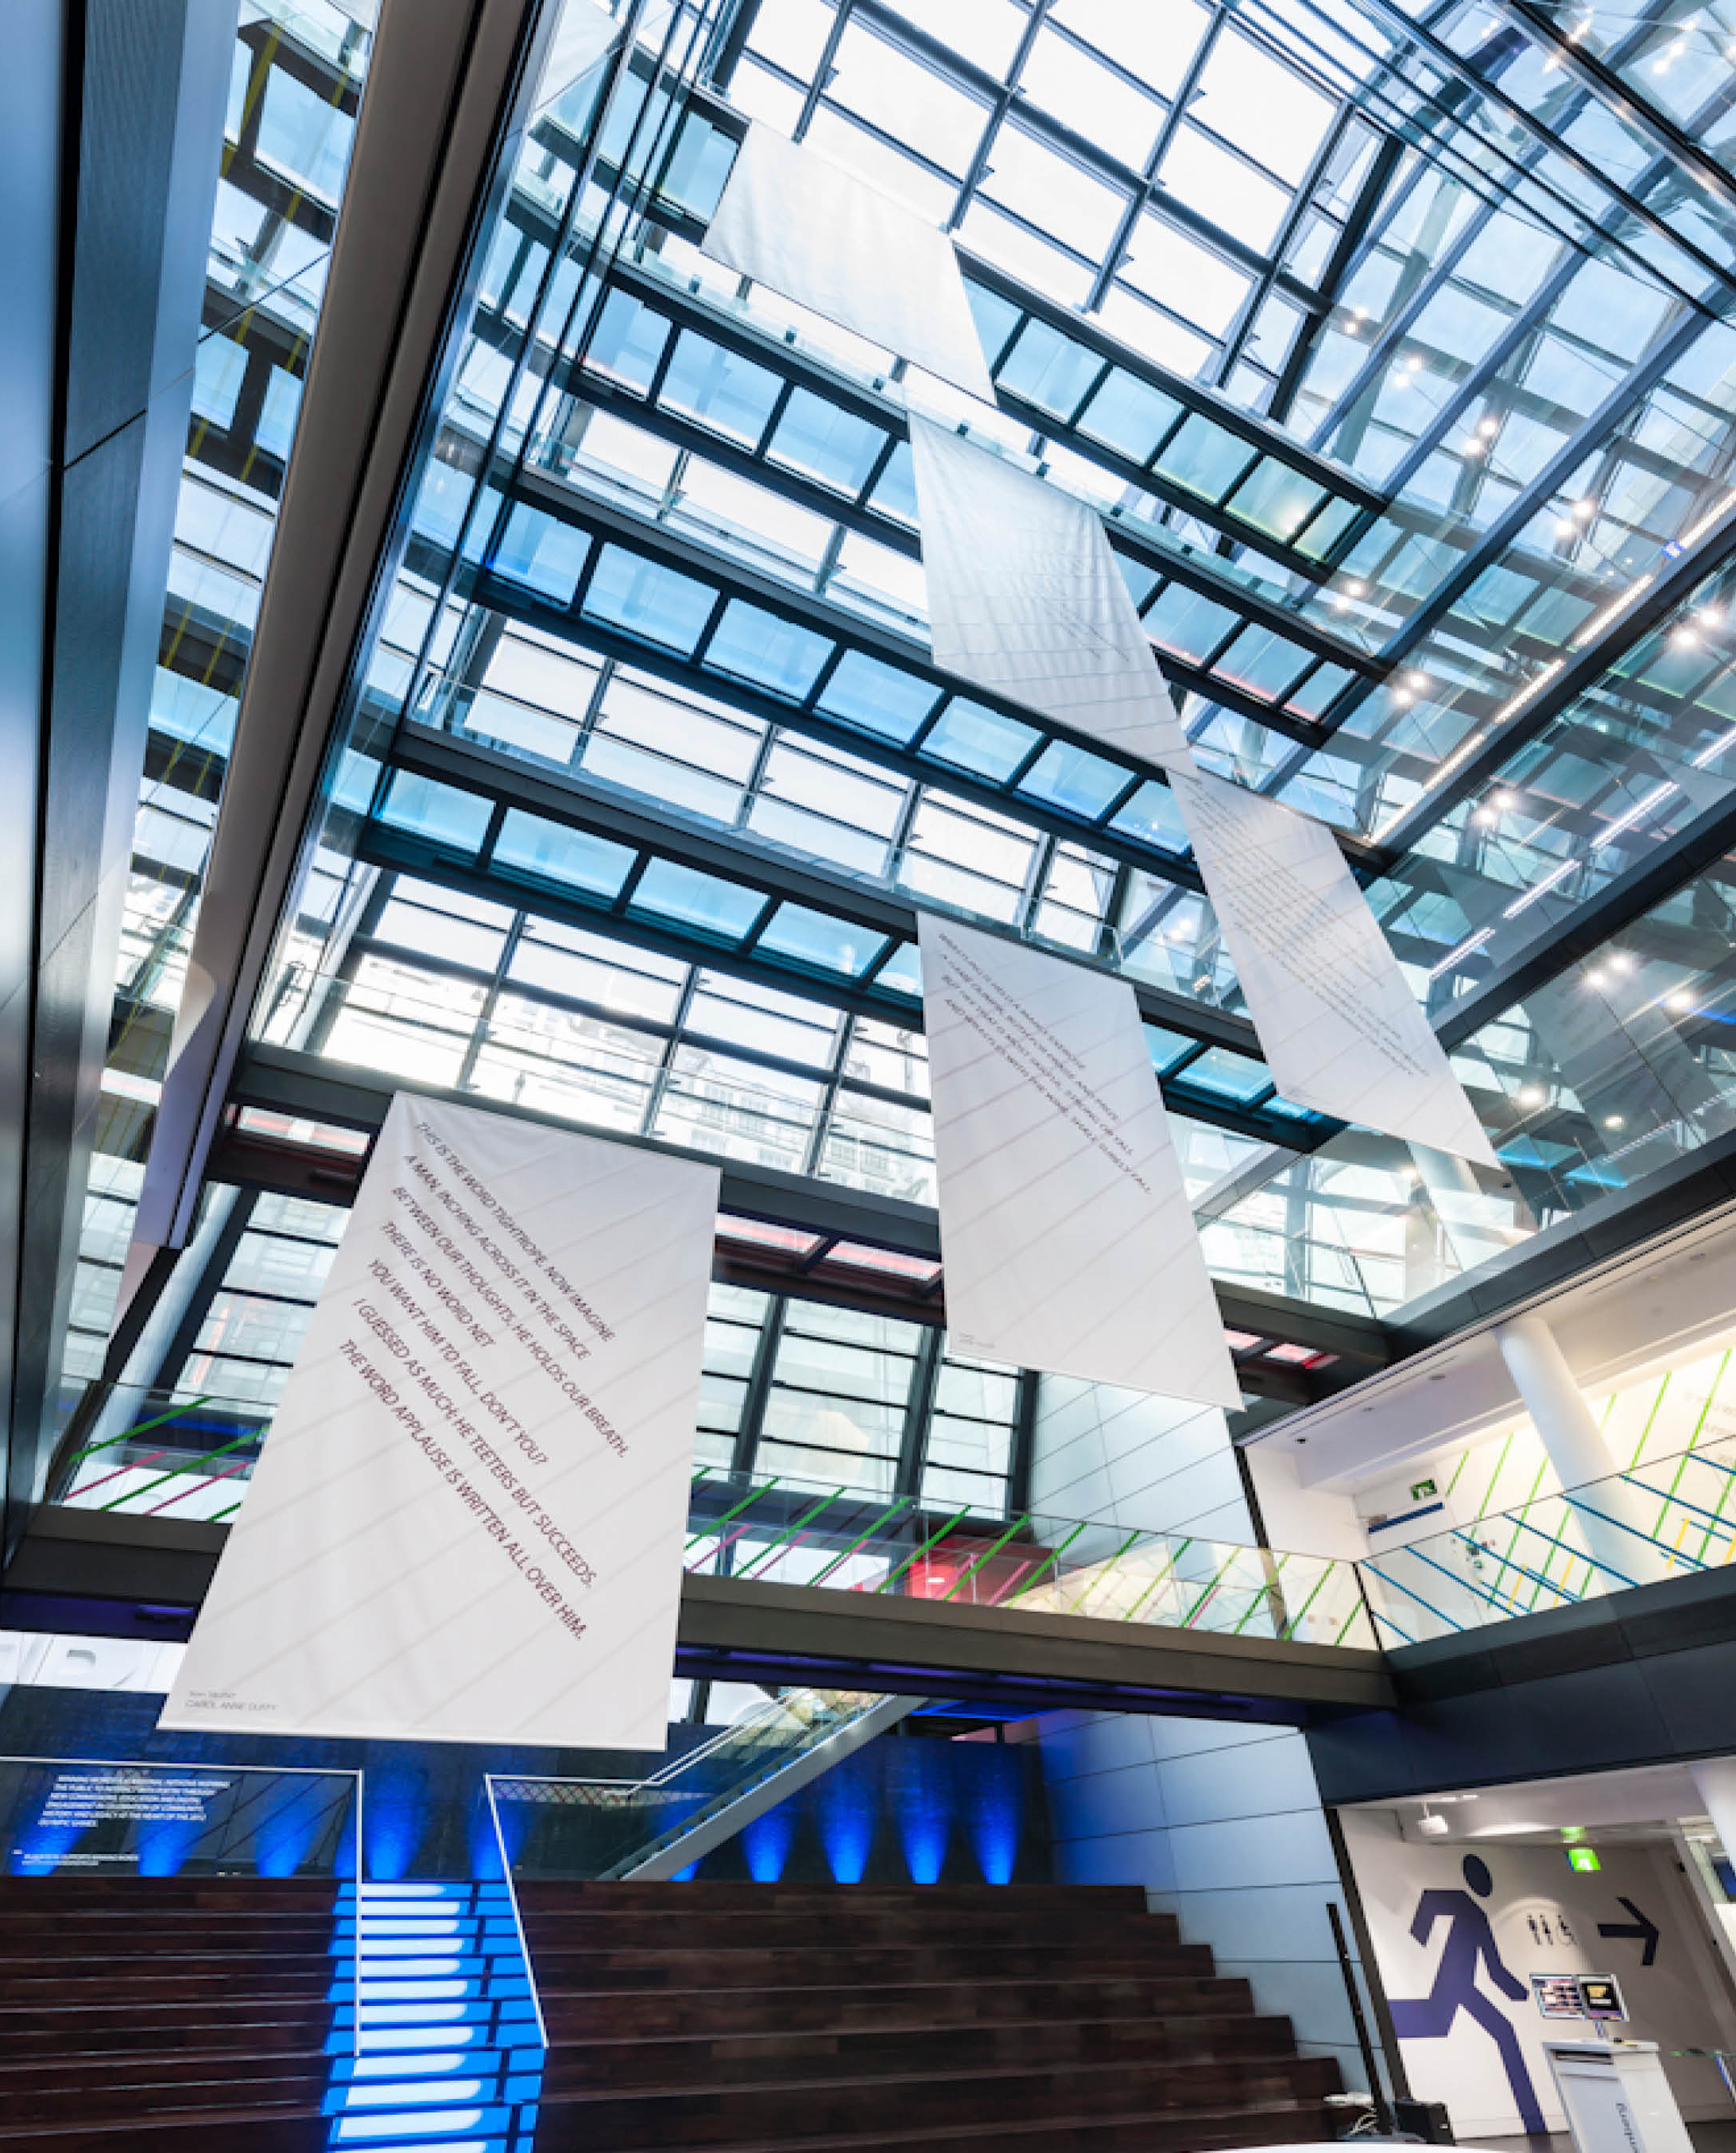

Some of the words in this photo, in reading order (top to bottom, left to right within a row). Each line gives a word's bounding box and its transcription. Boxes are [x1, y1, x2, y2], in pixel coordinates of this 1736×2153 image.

[382, 1221, 417, 1258] THERE
[409, 1257, 427, 1270] IS
[420, 1268, 442, 1289] NO
[436, 1286, 473, 1325] WORD
[392, 1187, 442, 1239] BETWEEN
[435, 1237, 465, 1263] OUR
[511, 1323, 533, 1342] HE
[527, 1341, 568, 1383] HOLDS
[561, 1382, 591, 1410] OUR
[405, 1155, 418, 1164] A
[436, 1191, 482, 1236] INCHING
[477, 1236, 520, 1279] ACROSS
[513, 1278, 530, 1288] IT
[524, 1289, 541, 1304] IN
[536, 1301, 560, 1326] THE
[553, 1323, 591, 1360] SPACE
[436, 1144, 451, 1157] IS
[445, 1154, 468, 1177] THE
[461, 1174, 497, 1208] WORD
[543, 1266, 575, 1295] NOW
[569, 1294, 615, 1342] IMAGINE
[358, 1305, 410, 1359] GUESSED
[403, 1360, 426, 1377] AS
[451, 1417, 476, 1438] HE
[469, 1434, 518, 1490] TEETERS
[510, 1487, 542, 1515] BUT
[368, 1259, 397, 1286] YOU
[389, 1282, 426, 1320] WANT
[417, 1319, 447, 1345] HIM
[440, 1343, 460, 1363] TO
[513, 1430, 548, 1464] YOU?
[339, 1339, 368, 1367] THE
[358, 1364, 400, 1406] WORD
[391, 1405, 452, 1472] APPLAUSE
[445, 1468, 464, 1485] IS
[455, 1480, 511, 1543] WRITTEN
[502, 1542, 529, 1571] ALL
[525, 1567, 563, 1608] OVER
